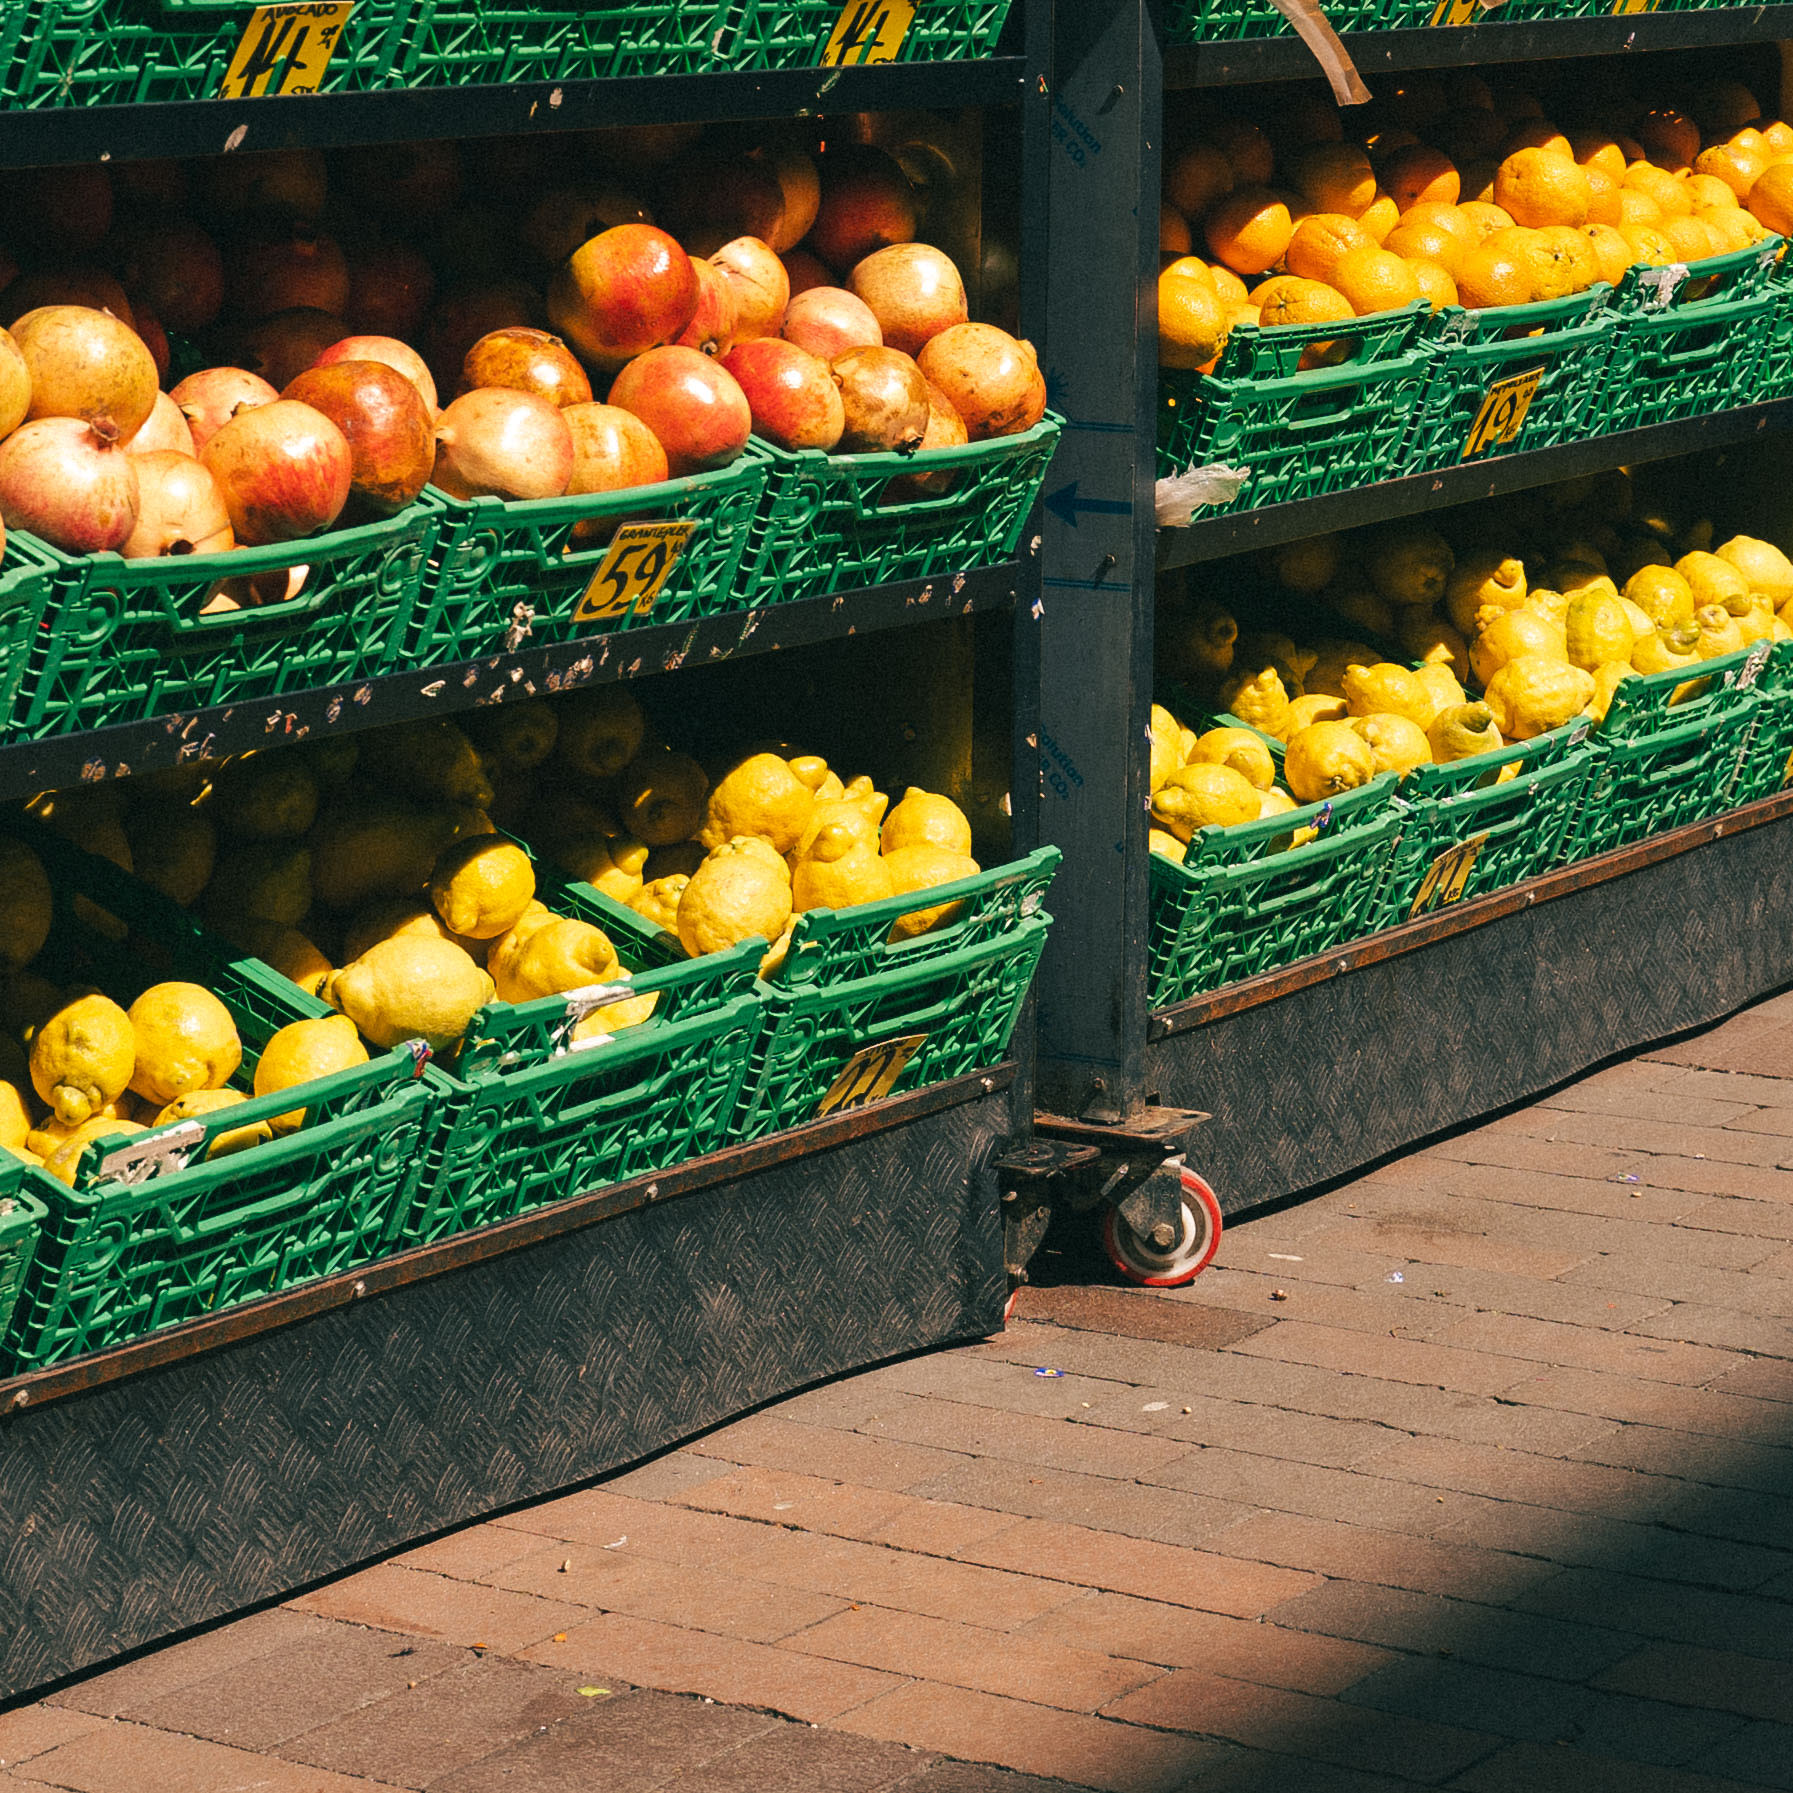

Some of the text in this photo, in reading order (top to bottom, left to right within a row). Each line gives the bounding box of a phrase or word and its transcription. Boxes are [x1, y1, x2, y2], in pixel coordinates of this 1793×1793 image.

[260, 3, 339, 23] AVOCADO
[236, 16, 309, 98] 14
[1470, 391, 1518, 454] 19
[582, 541, 668, 615] 59
[1042, 722, 1084, 789] olution
